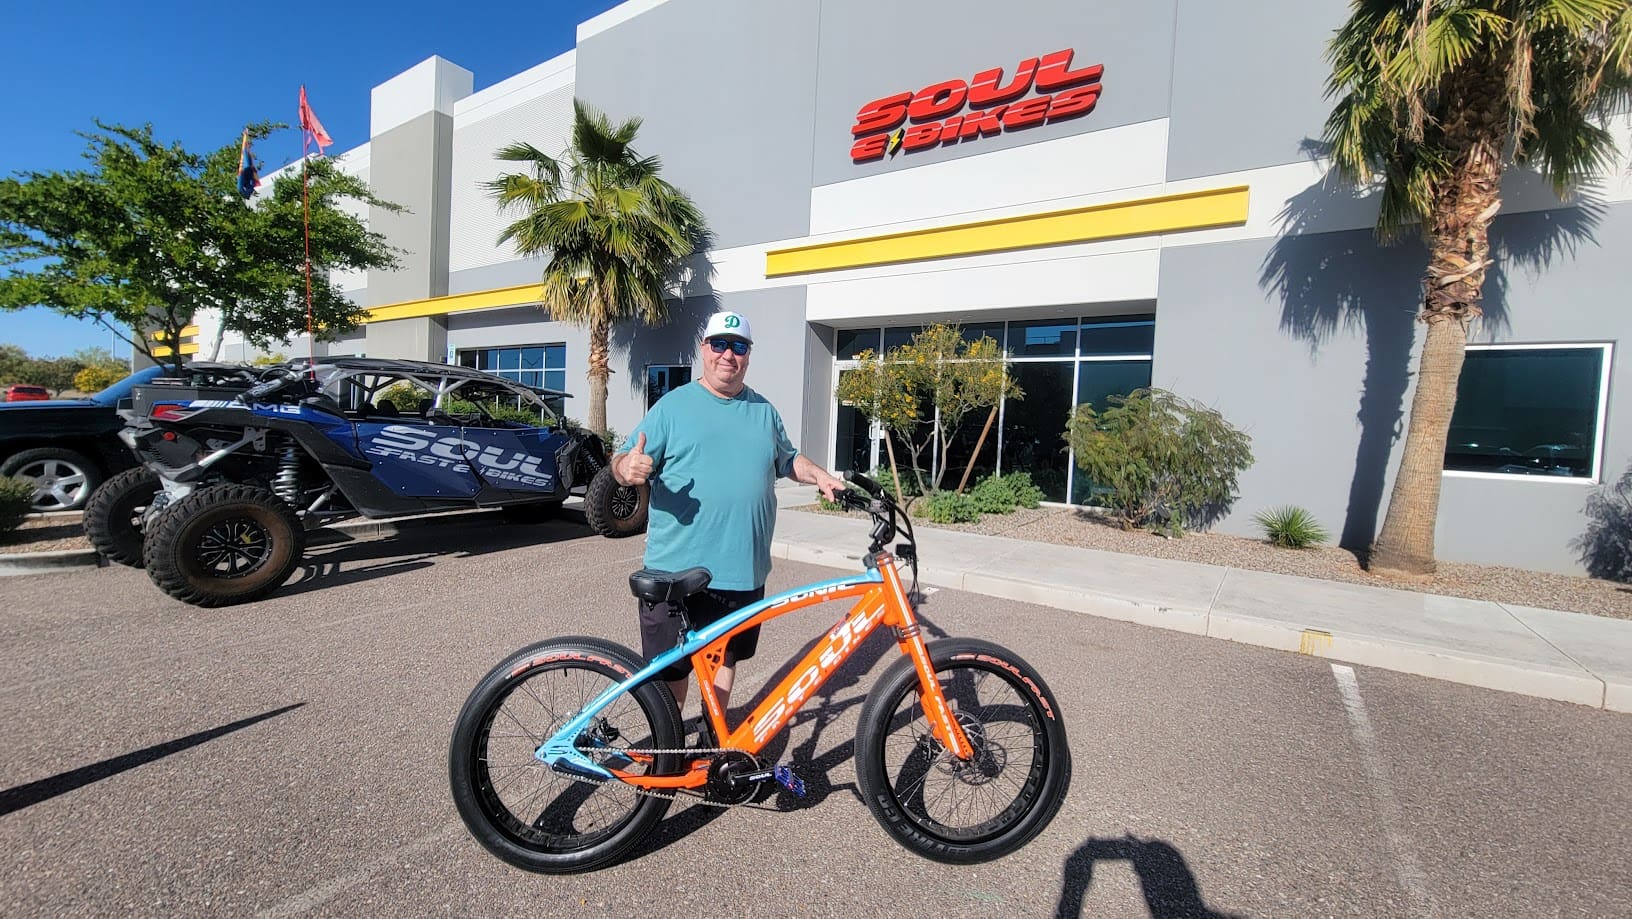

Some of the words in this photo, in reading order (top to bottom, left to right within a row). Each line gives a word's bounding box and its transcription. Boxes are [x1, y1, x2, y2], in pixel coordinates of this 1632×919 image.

[851, 48, 1104, 136] SOUL
[724, 315, 741, 329] D
[371, 425, 553, 480] SOUL
[532, 651, 587, 666] SOUL
[753, 603, 885, 743] SOUL
[976, 654, 1022, 679] SOUL
[1022, 676, 1056, 720] FAST
[749, 772, 772, 781] SOUL
